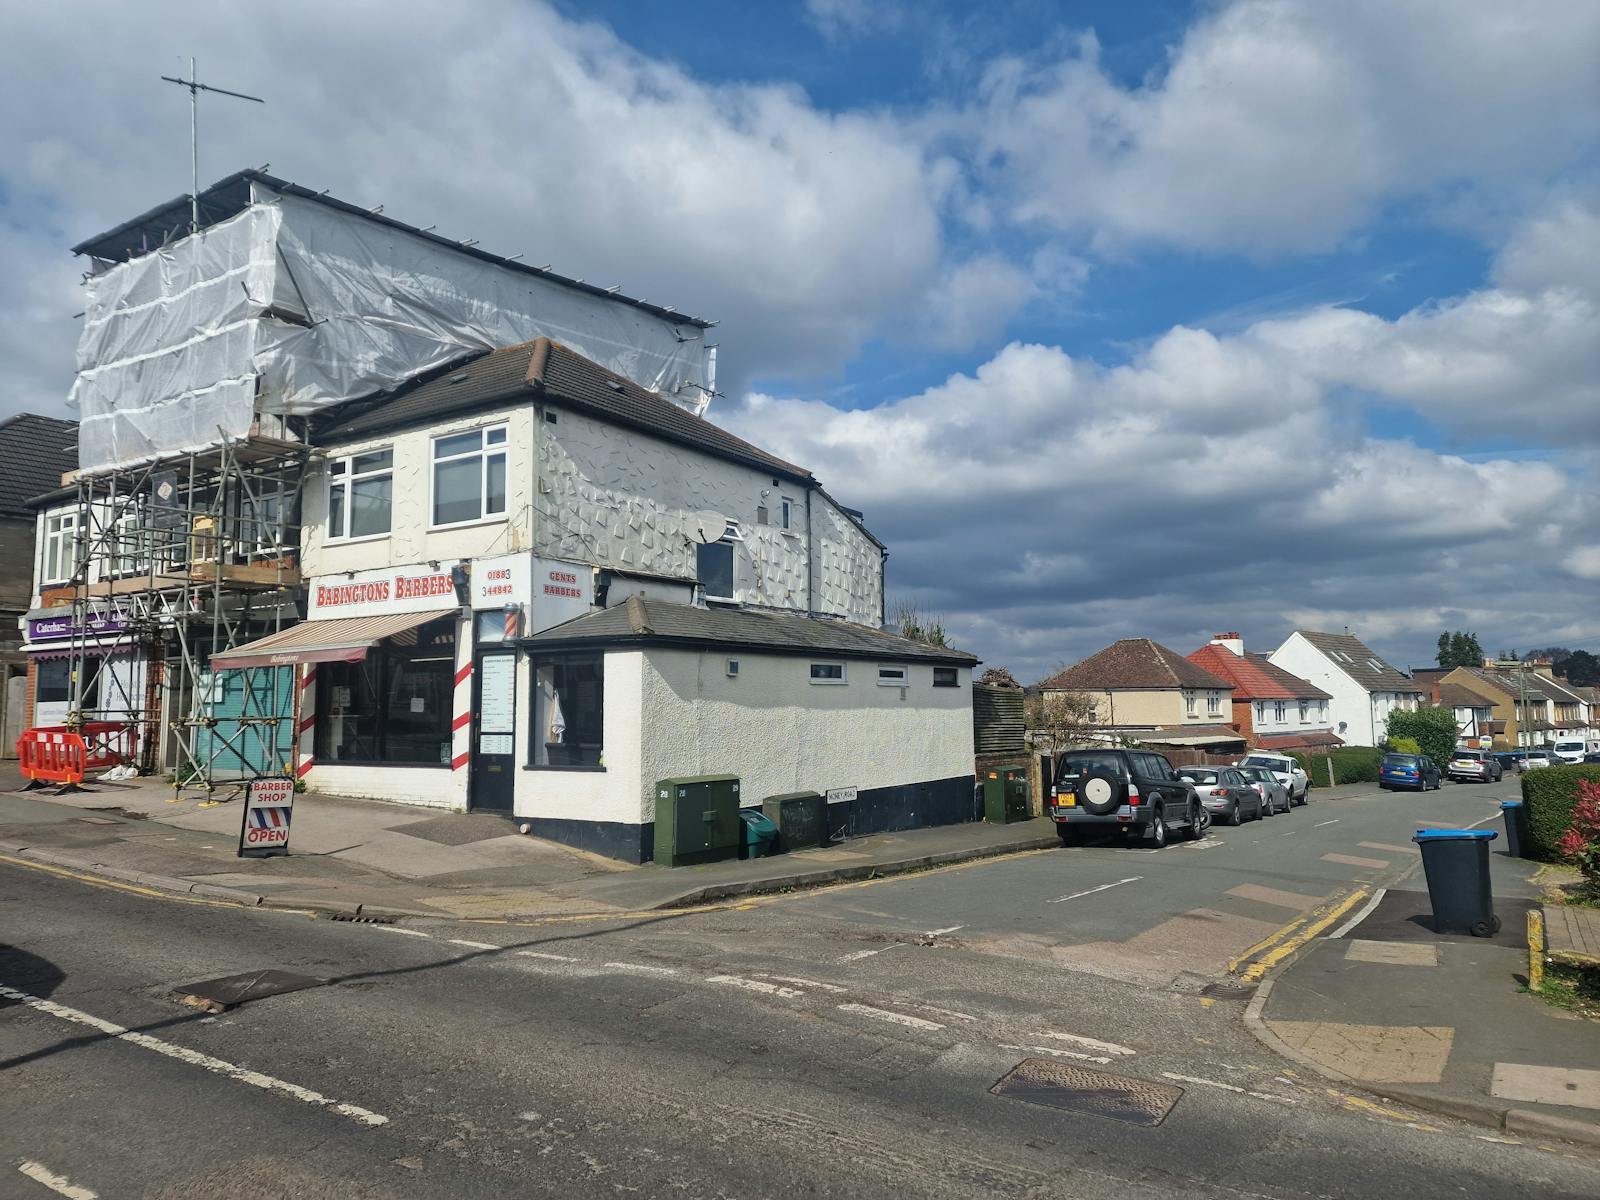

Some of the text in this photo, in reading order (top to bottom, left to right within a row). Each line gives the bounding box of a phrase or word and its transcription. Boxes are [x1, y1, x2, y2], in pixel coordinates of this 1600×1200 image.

[487, 569, 511, 580] 01883
[550, 571, 577, 583] GENTS
[316, 574, 454, 608] BABINGTONS BARBERS
[482, 585, 513, 597] 344842
[543, 584, 582, 598] BARBERS
[254, 782, 293, 791] BARBER
[257, 793, 287, 802] SHOP
[248, 830, 286, 843] OPEN
